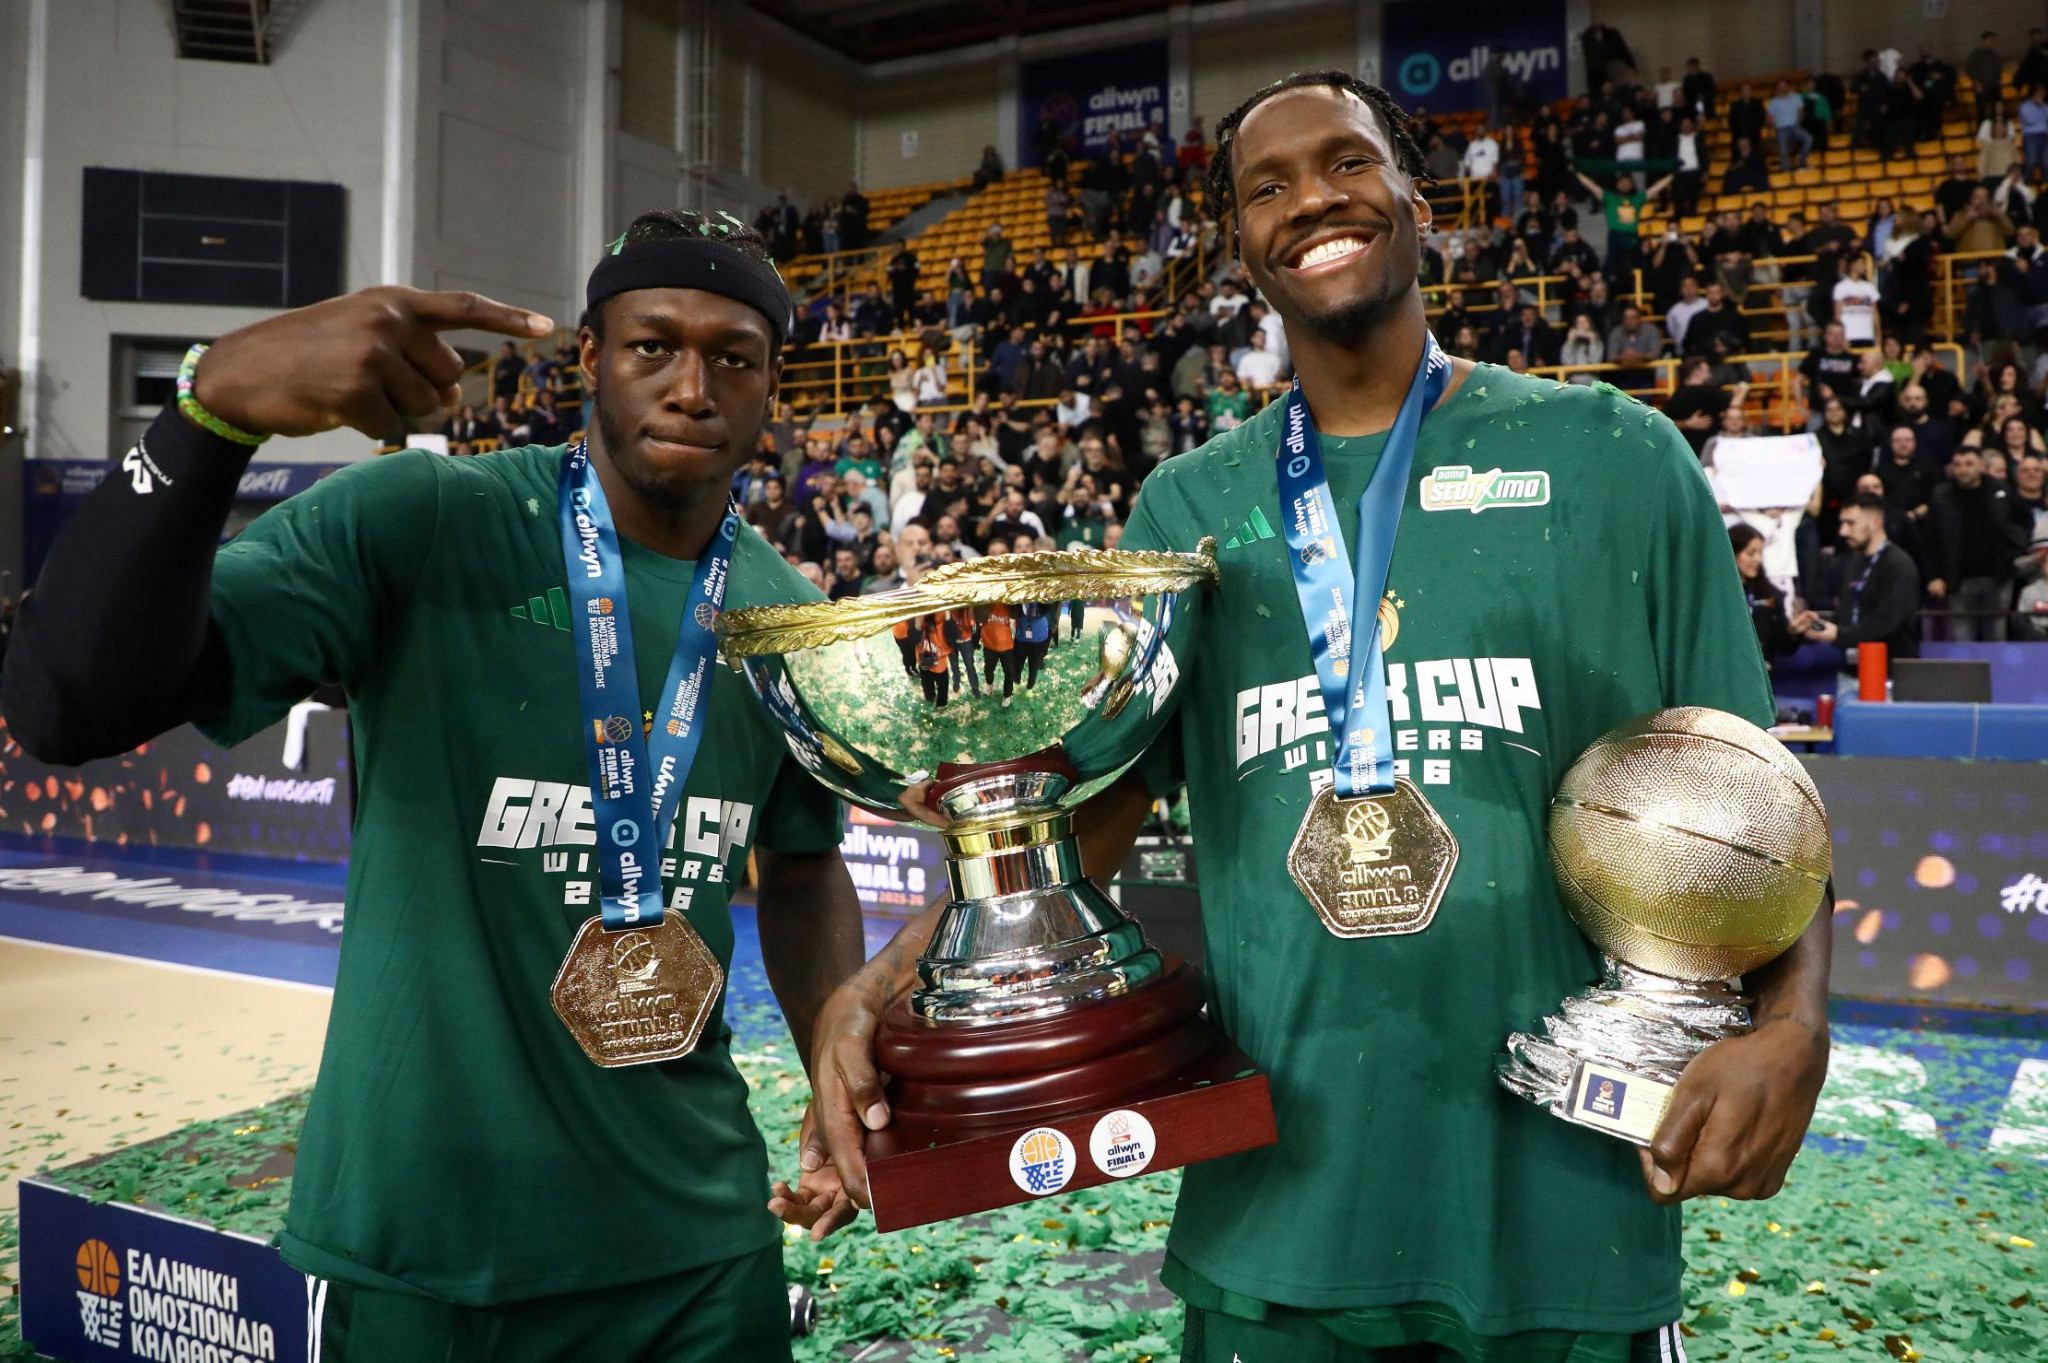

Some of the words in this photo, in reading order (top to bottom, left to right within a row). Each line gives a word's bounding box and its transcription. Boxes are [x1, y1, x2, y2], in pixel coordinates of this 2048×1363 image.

[1448, 46, 1559, 82] allwyn
[1089, 86, 1159, 110] allwyn
[1084, 111, 1146, 135] FINAL
[1286, 403, 1305, 454] allwyn
[1304, 489, 1313, 499] 8
[1293, 498, 1309, 537] allwyn
[1306, 499, 1323, 536] FINAL
[575, 514, 602, 578] allwyn
[704, 556, 720, 597] allwyn
[712, 570, 727, 605] FINAL
[589, 617, 605, 689] ΚΑΛΑΘΟΣΦΑΙΡΙΣΗΣ
[598, 616, 611, 667] ΟΜΟΣΠΟΝΔΙΑ
[606, 616, 619, 655] ΕΛΛΗΝΙΚΗ
[670, 680, 688, 717] ΕΛΛΗΝΙΚΗ
[678, 672, 697, 719] ΟΜΟΣΠΟΝΔΙΑ
[1236, 663, 1412, 771] GREK
[1414, 657, 1542, 734] CUP
[605, 747, 620, 788] FINAL
[1284, 729, 1483, 770] WIERS
[620, 749, 635, 794] allwyn
[476, 776, 679, 849] GRE
[610, 790, 621, 799] 8
[839, 825, 919, 866] allwyn
[543, 852, 724, 883] WIERS
[617, 852, 643, 922] allwyn
[907, 867, 926, 892] 8
[564, 881, 694, 910] 26
[1337, 887, 1402, 911] FINAL
[1403, 885, 1419, 902] 8
[669, 1013, 683, 1030] 8
[1107, 1142, 1141, 1156] allwyn
[1107, 1154, 1137, 1168] FINAL
[1138, 1151, 1146, 1160] 8
[127, 1248, 238, 1313] ΕΛΛΗΝΙΚΗ
[129, 1286, 275, 1361] ΟΜΟΣΠΟΝΔΙΑ
